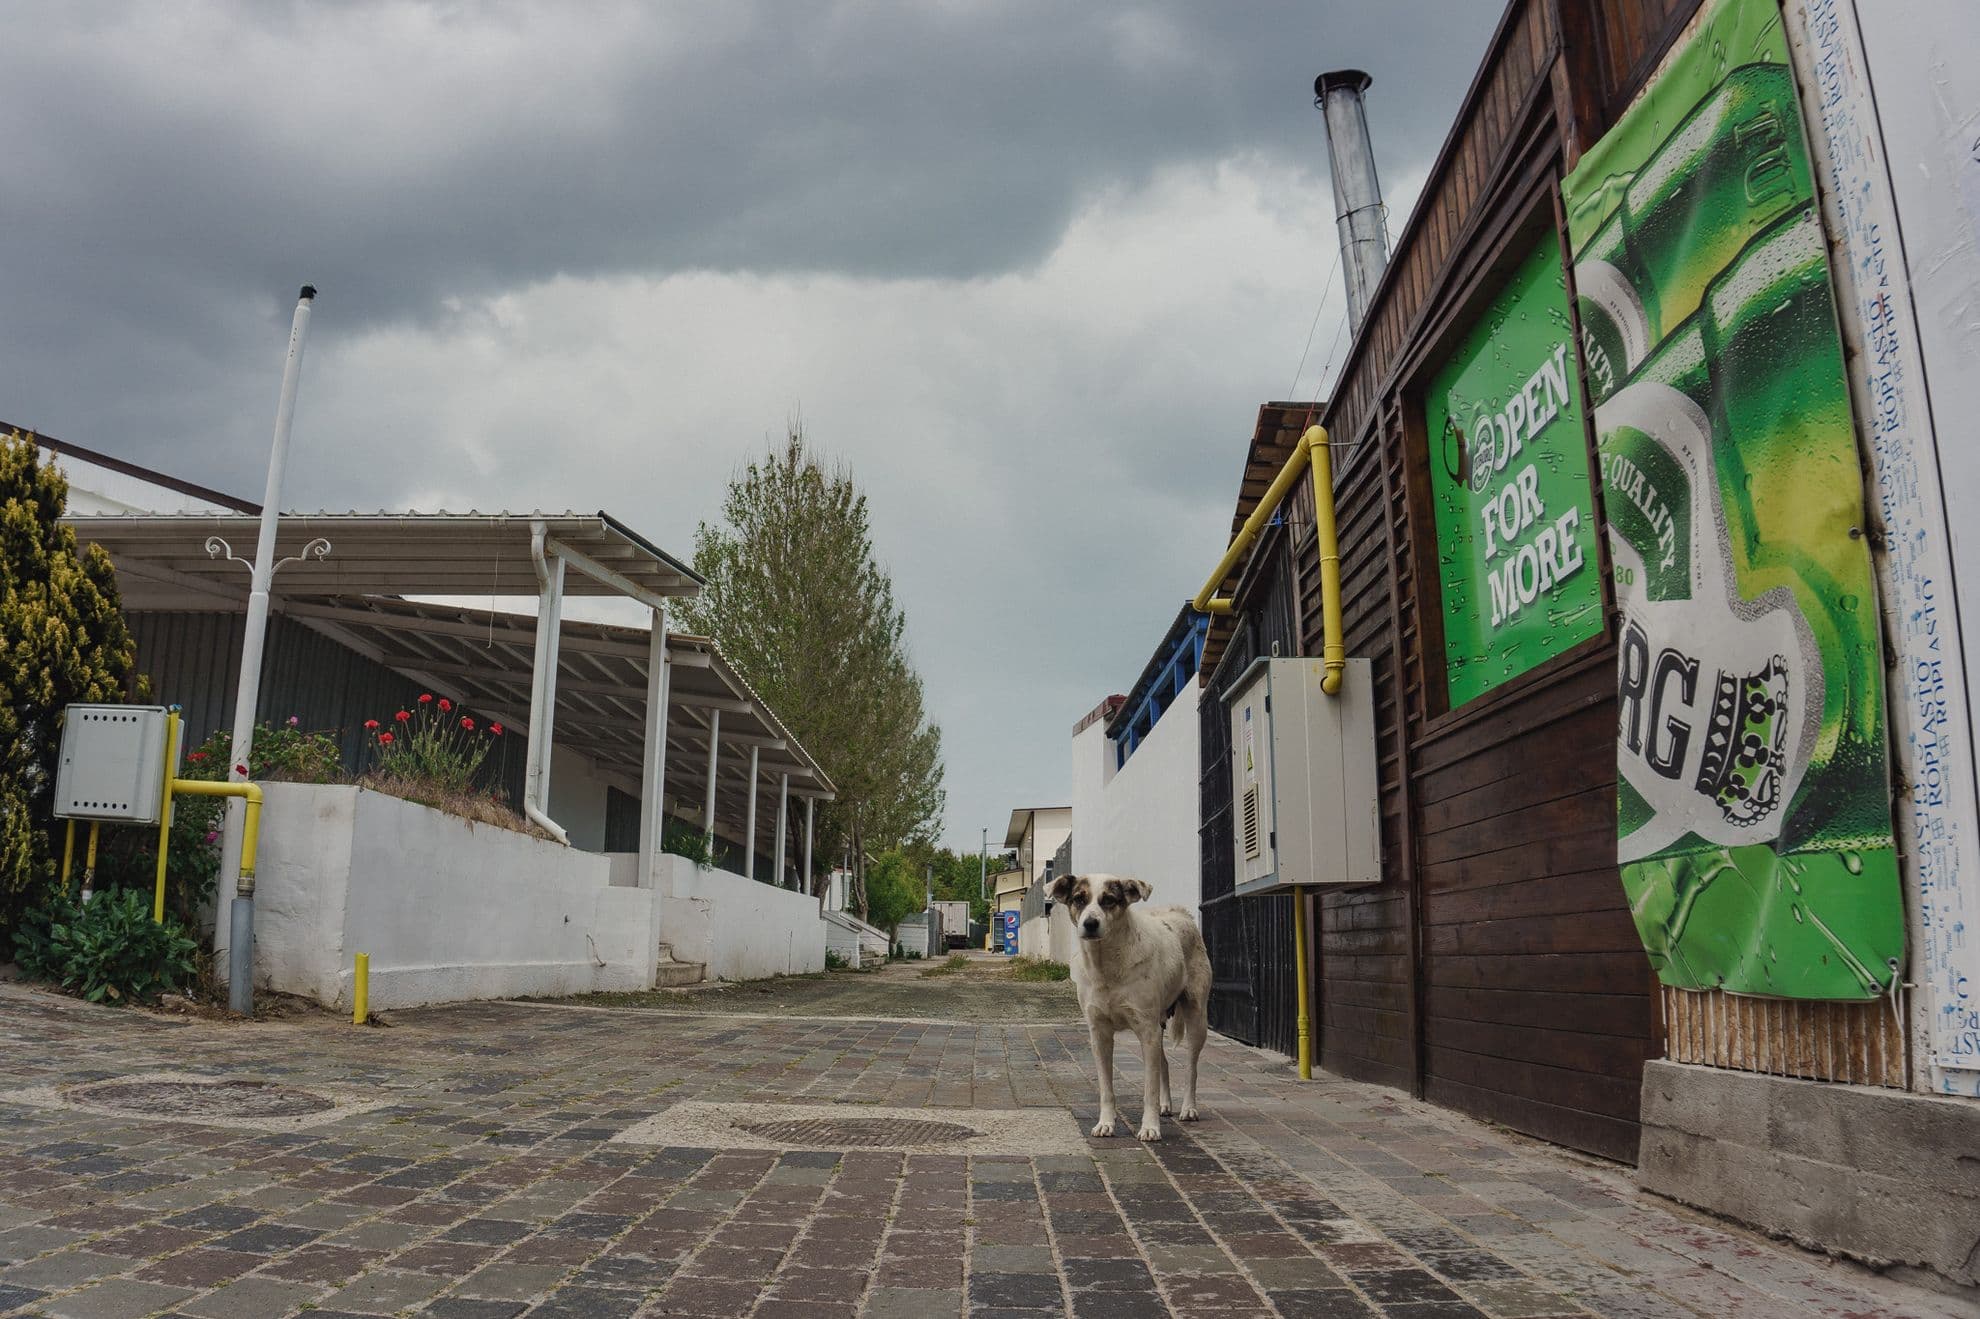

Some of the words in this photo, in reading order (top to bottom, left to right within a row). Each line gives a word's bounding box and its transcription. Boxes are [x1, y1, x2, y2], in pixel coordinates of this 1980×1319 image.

[1495, 342, 1570, 472] OPEN
[1480, 463, 1545, 560] FOR
[1487, 506, 1584, 627] MORE
[1610, 455, 1676, 574] QUALITY
[1917, 661, 1944, 807] ROPLASTO
